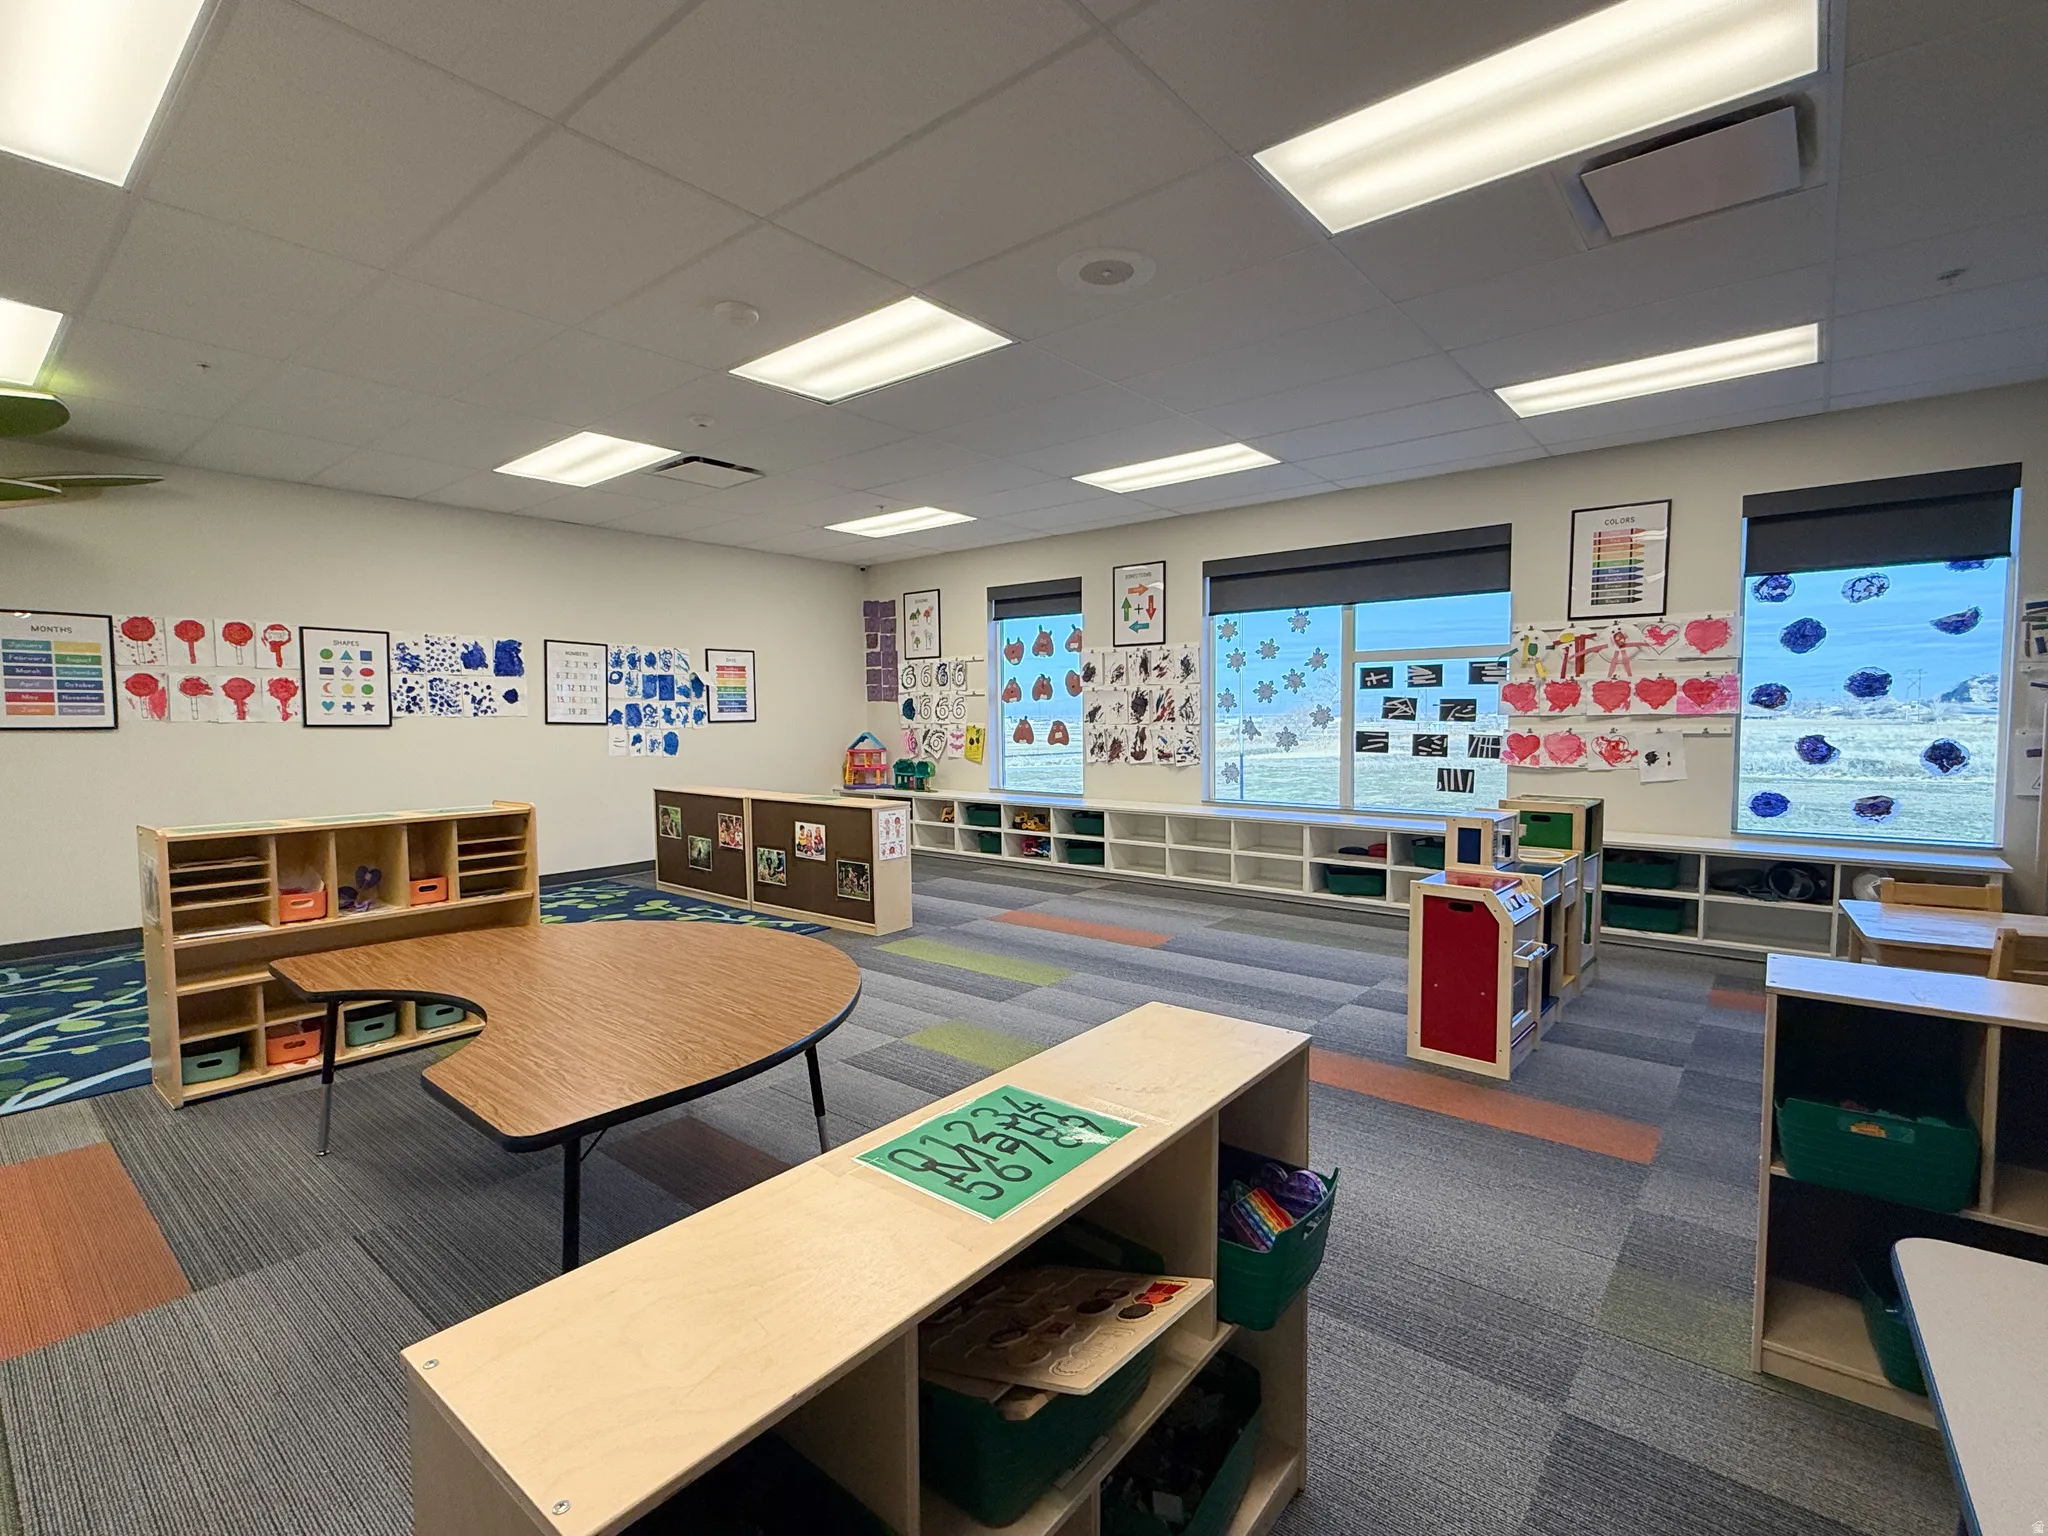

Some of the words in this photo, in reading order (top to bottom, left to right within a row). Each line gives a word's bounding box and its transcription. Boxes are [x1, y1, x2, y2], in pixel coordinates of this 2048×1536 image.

[1604, 516, 1635, 526] COLORS
[30, 625, 72, 634] MONTHS
[902, 666, 917, 688] 6
[920, 664, 932, 688] 6
[920, 697, 932, 720] 6
[935, 697, 949, 719] 6
[952, 696, 966, 719] 6
